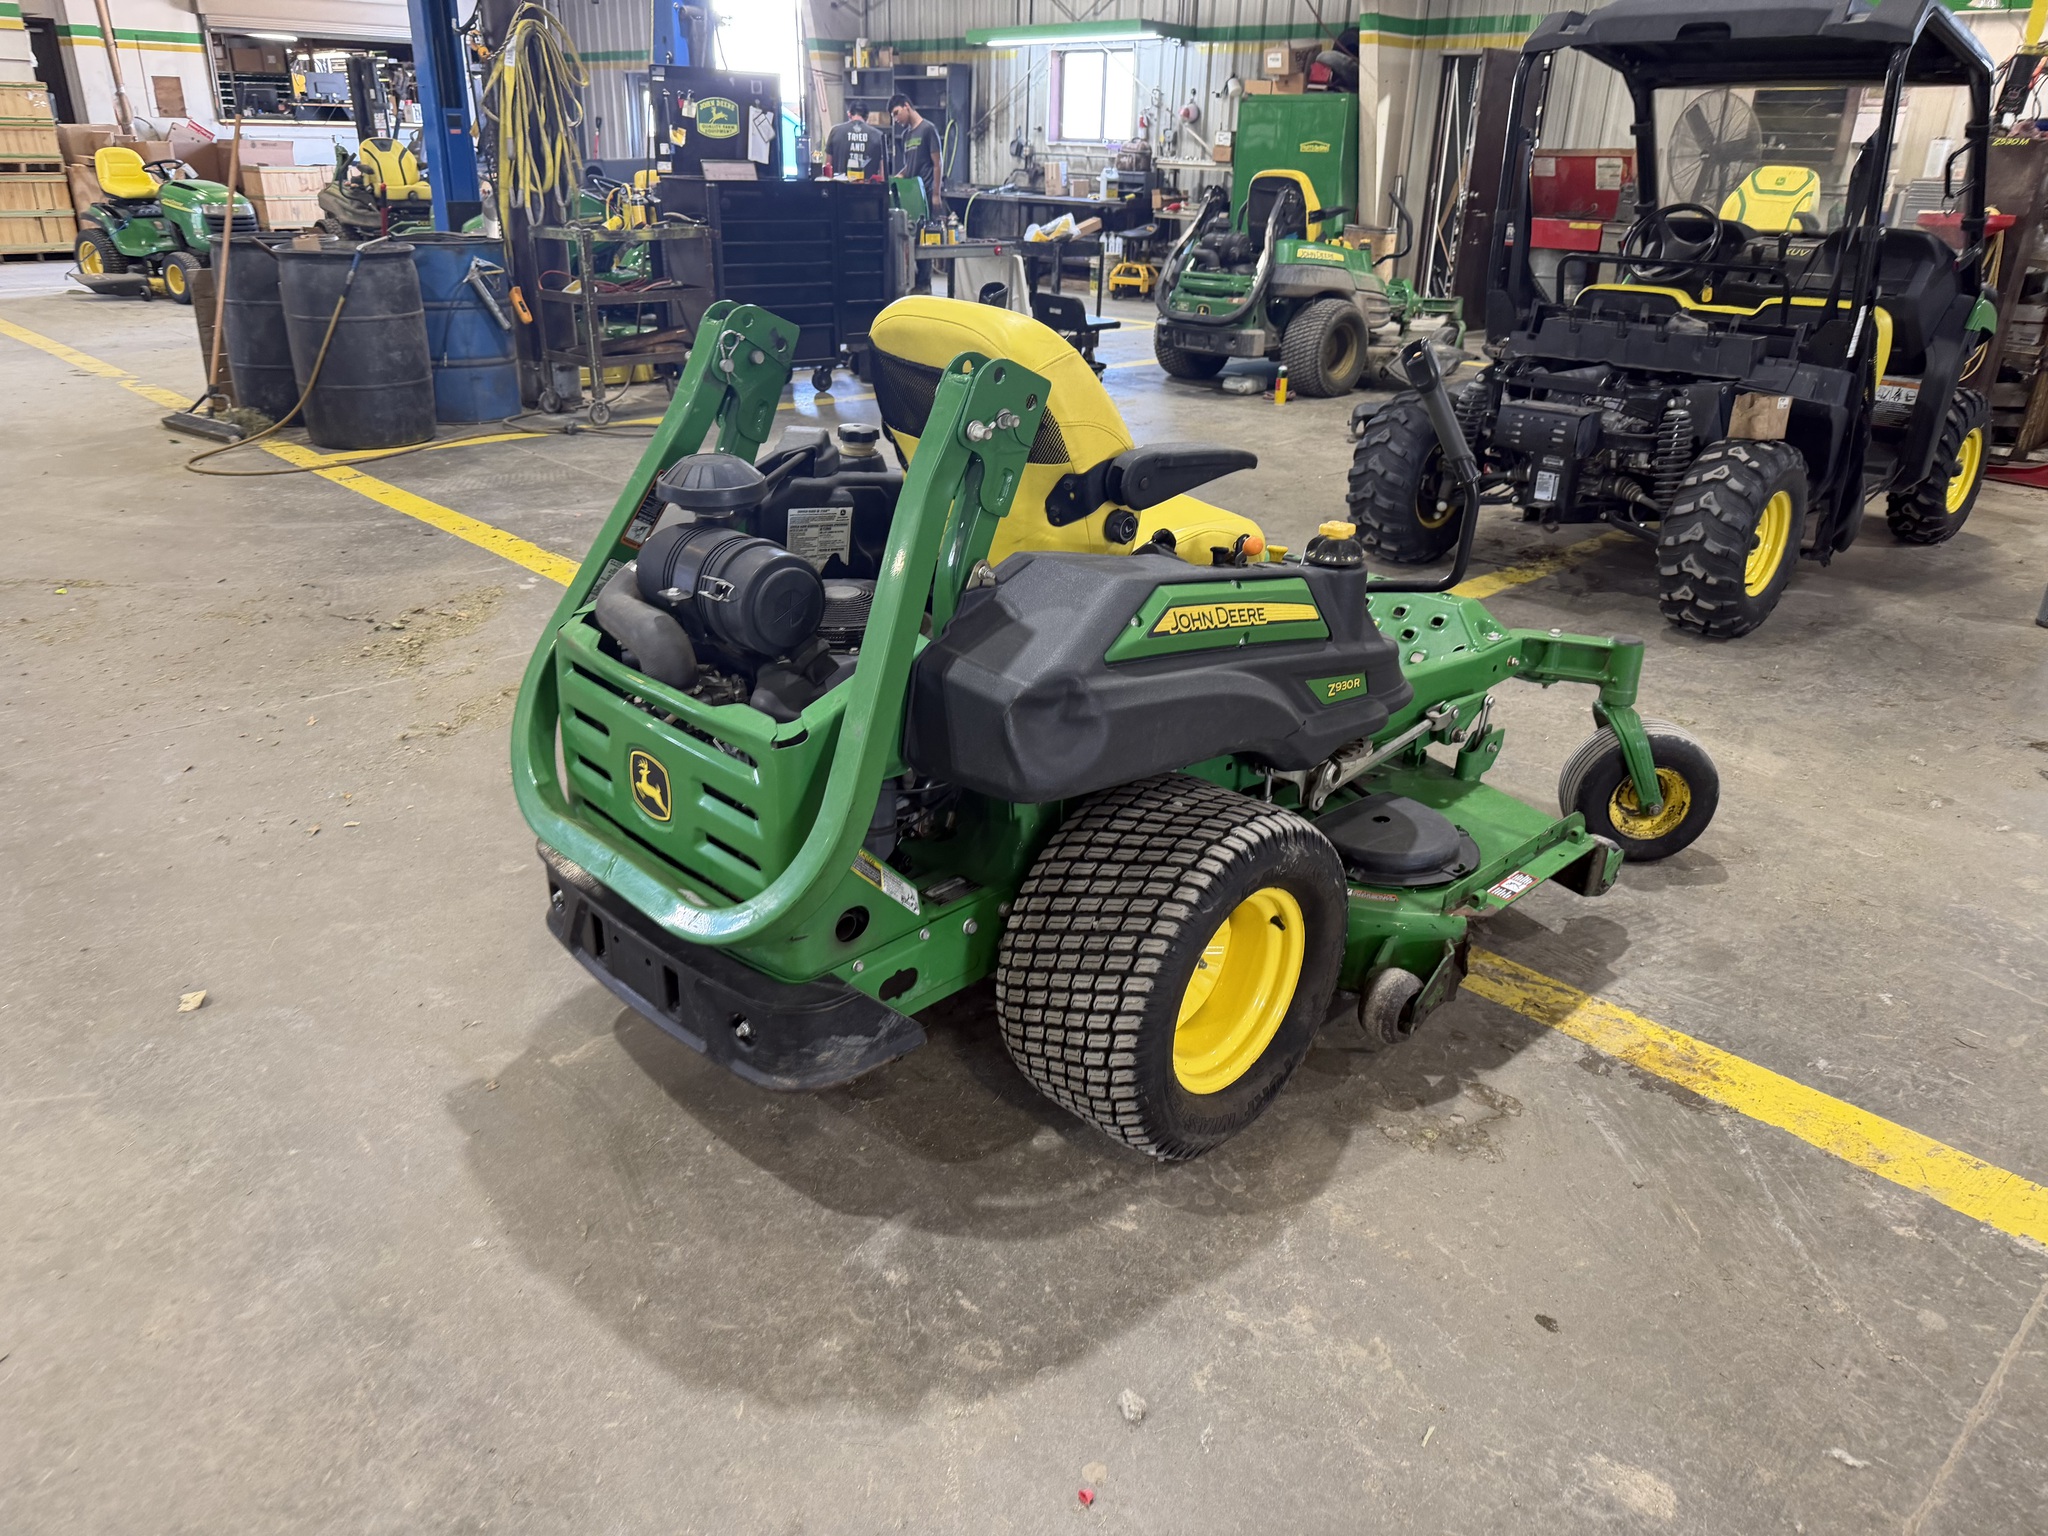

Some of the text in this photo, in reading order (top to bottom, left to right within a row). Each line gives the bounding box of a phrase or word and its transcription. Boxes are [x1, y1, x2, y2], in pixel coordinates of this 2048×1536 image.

[699, 100, 735, 111] JOHN DEERE
[847, 132, 868, 142] TRIED
[850, 143, 865, 152] AND
[1170, 606, 1267, 632] JOHN DEERE
[1327, 677, 1361, 697] Z930R
